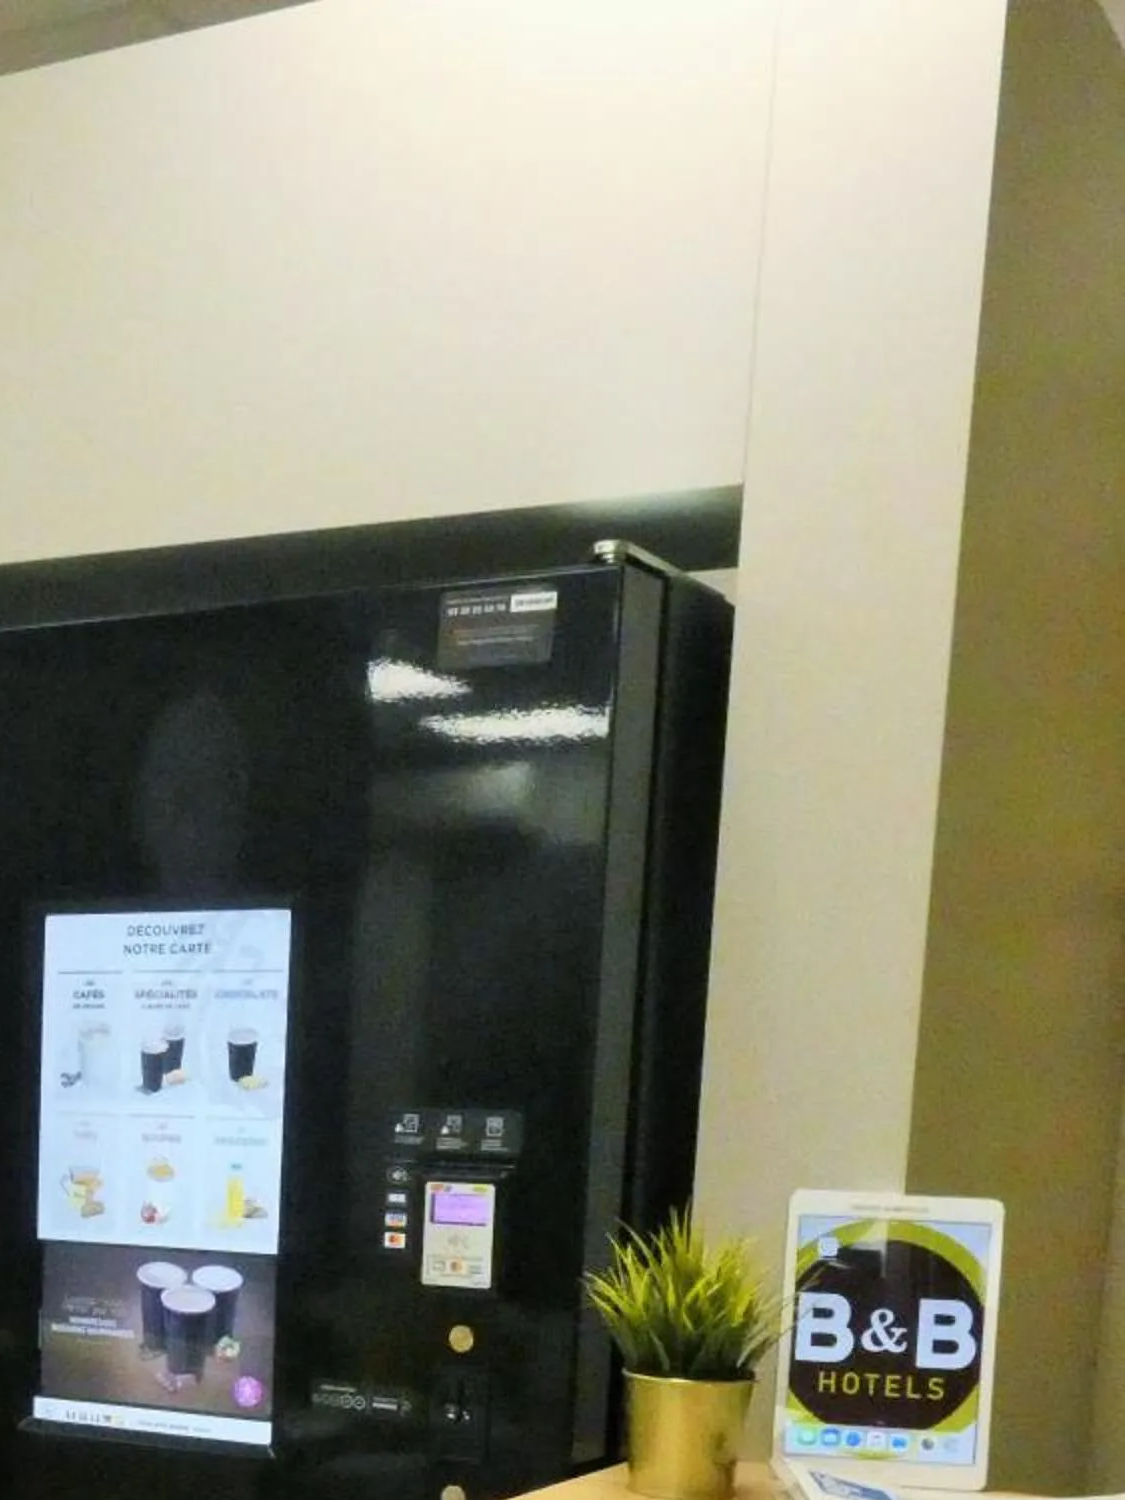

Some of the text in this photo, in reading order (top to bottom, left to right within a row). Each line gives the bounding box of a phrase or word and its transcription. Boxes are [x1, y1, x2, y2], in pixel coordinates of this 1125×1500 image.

[123, 942, 211, 956] NOTRE CARTE
[818, 1371, 945, 1401] HOTELS
